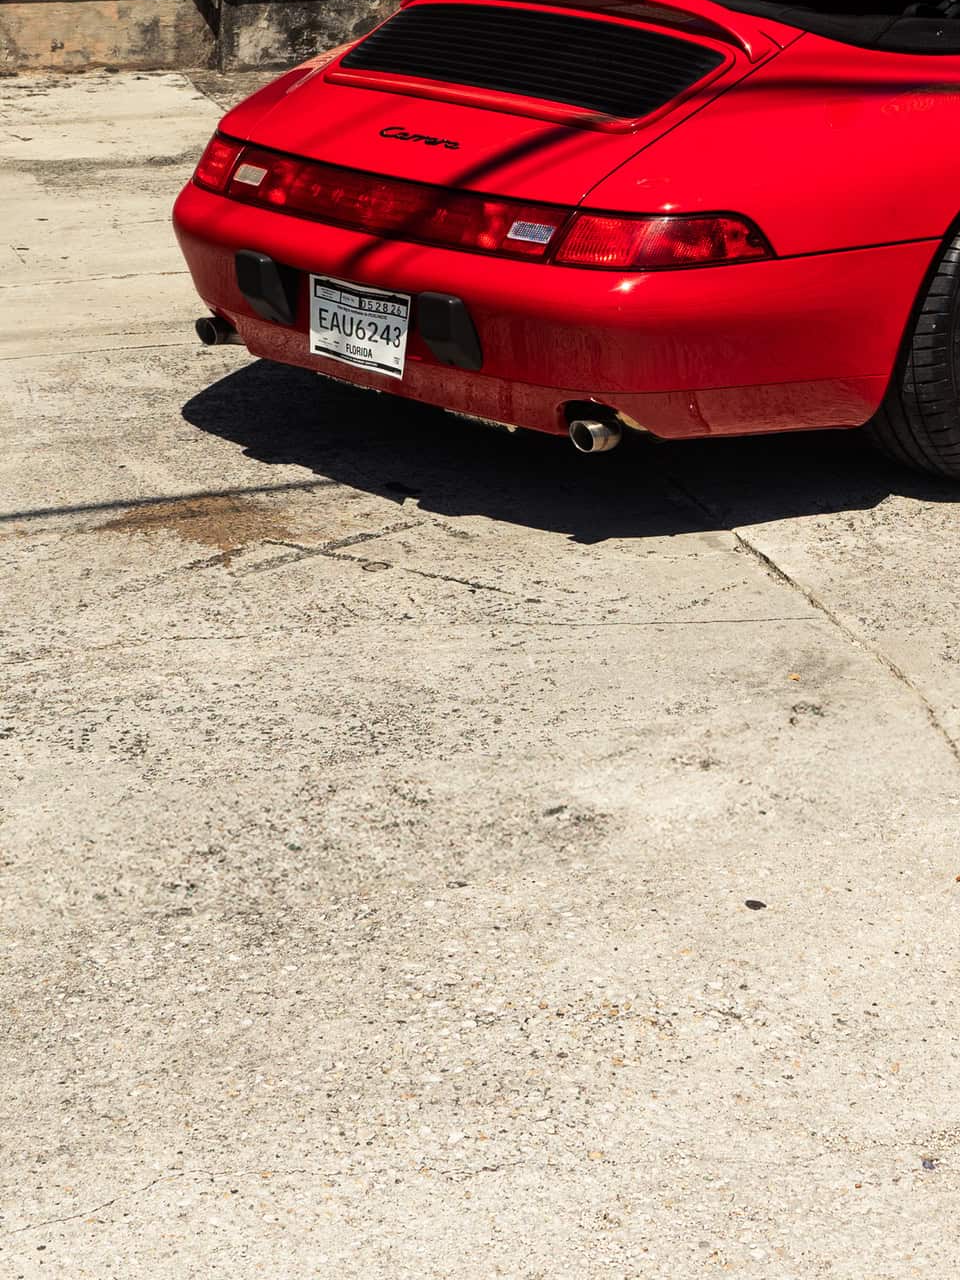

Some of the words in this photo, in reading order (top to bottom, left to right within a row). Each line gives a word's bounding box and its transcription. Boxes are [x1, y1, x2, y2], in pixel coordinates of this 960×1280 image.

[379, 126, 460, 150] Carrera
[318, 307, 402, 349] EAU6243
[345, 343, 373, 359] FLORIDA
